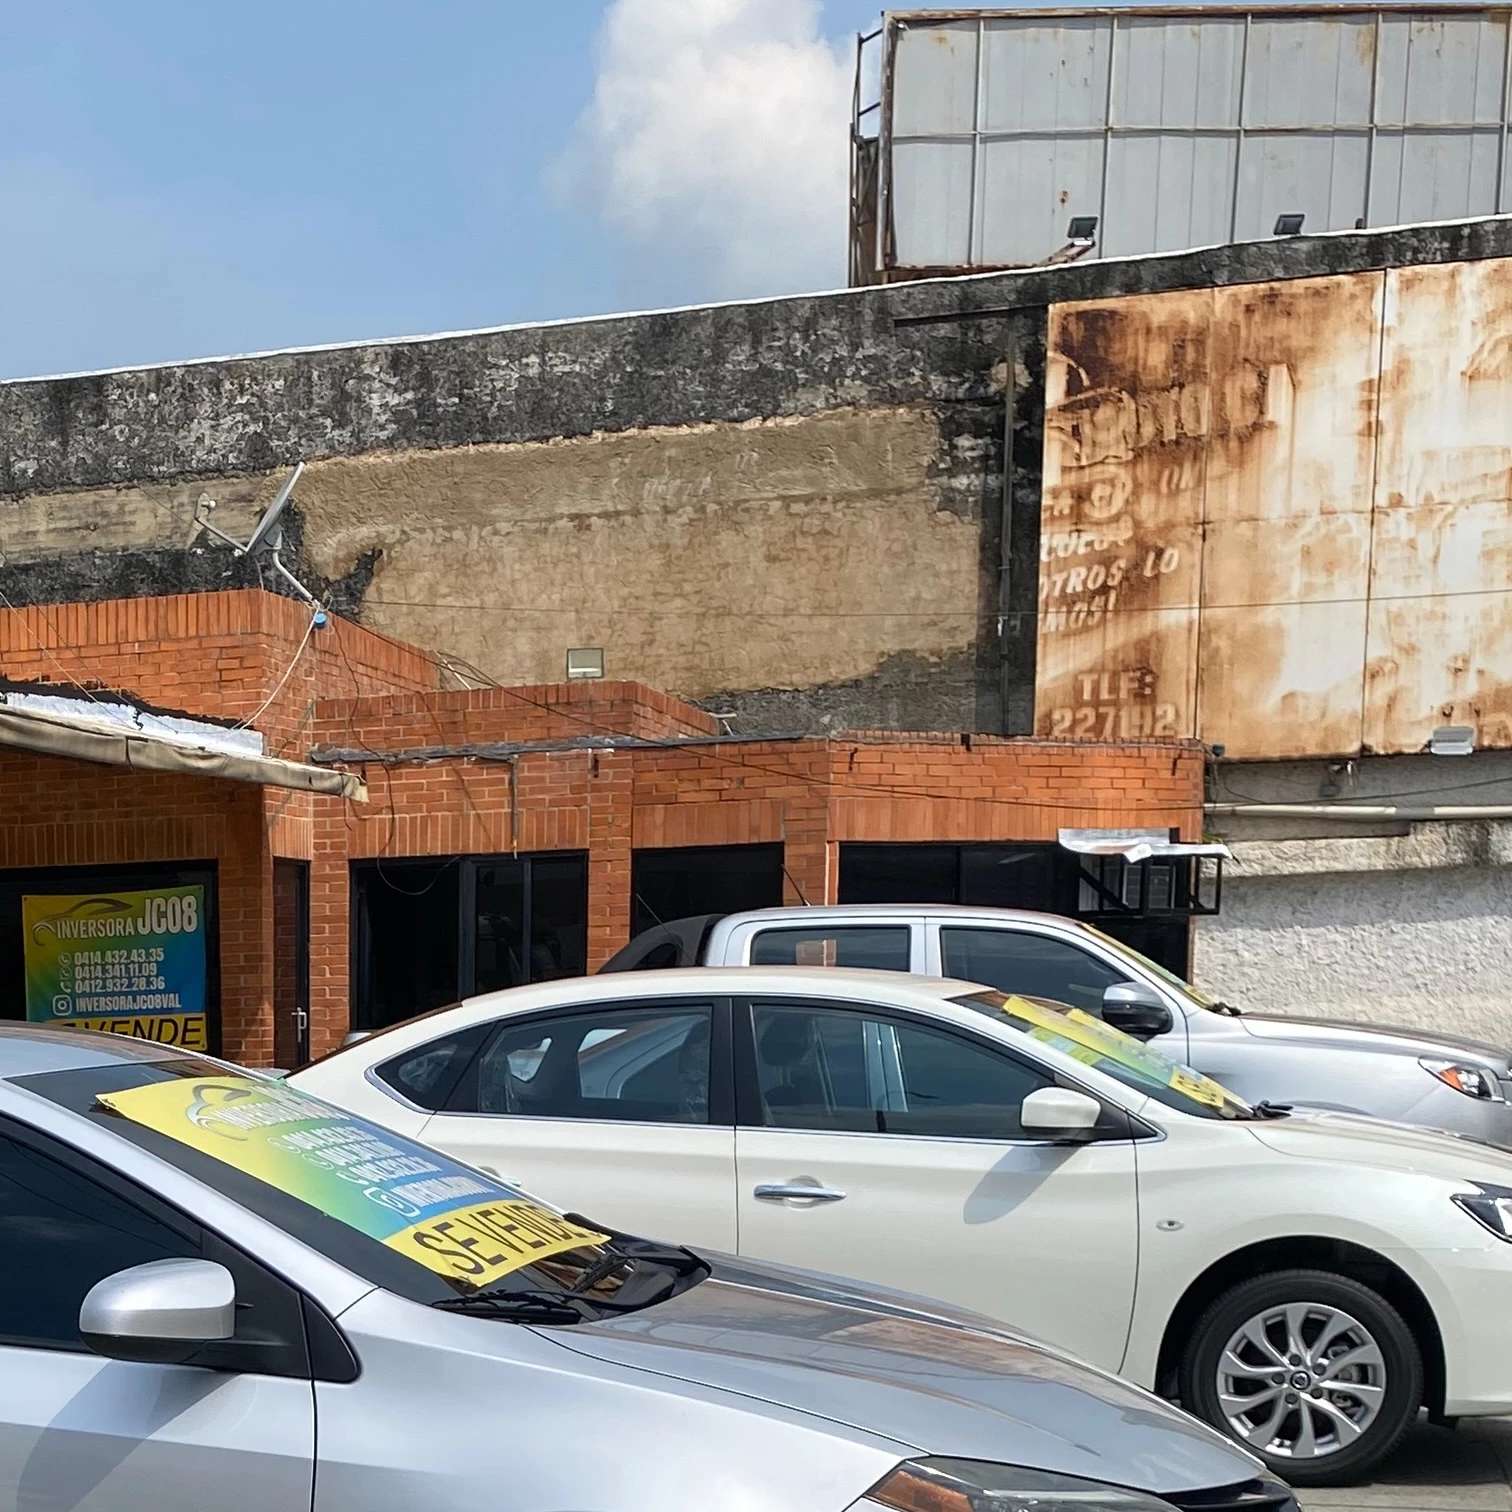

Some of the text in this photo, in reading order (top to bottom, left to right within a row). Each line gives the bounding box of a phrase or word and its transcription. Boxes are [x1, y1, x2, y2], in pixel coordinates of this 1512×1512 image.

[56, 916, 136, 939] INVERSORA
[74, 947, 165, 966] 0414.432.43.35
[74, 962, 157, 980] 0414.341.11.09
[75, 976, 166, 994] 0412.932.28.36
[413, 1221, 509, 1275] SE
